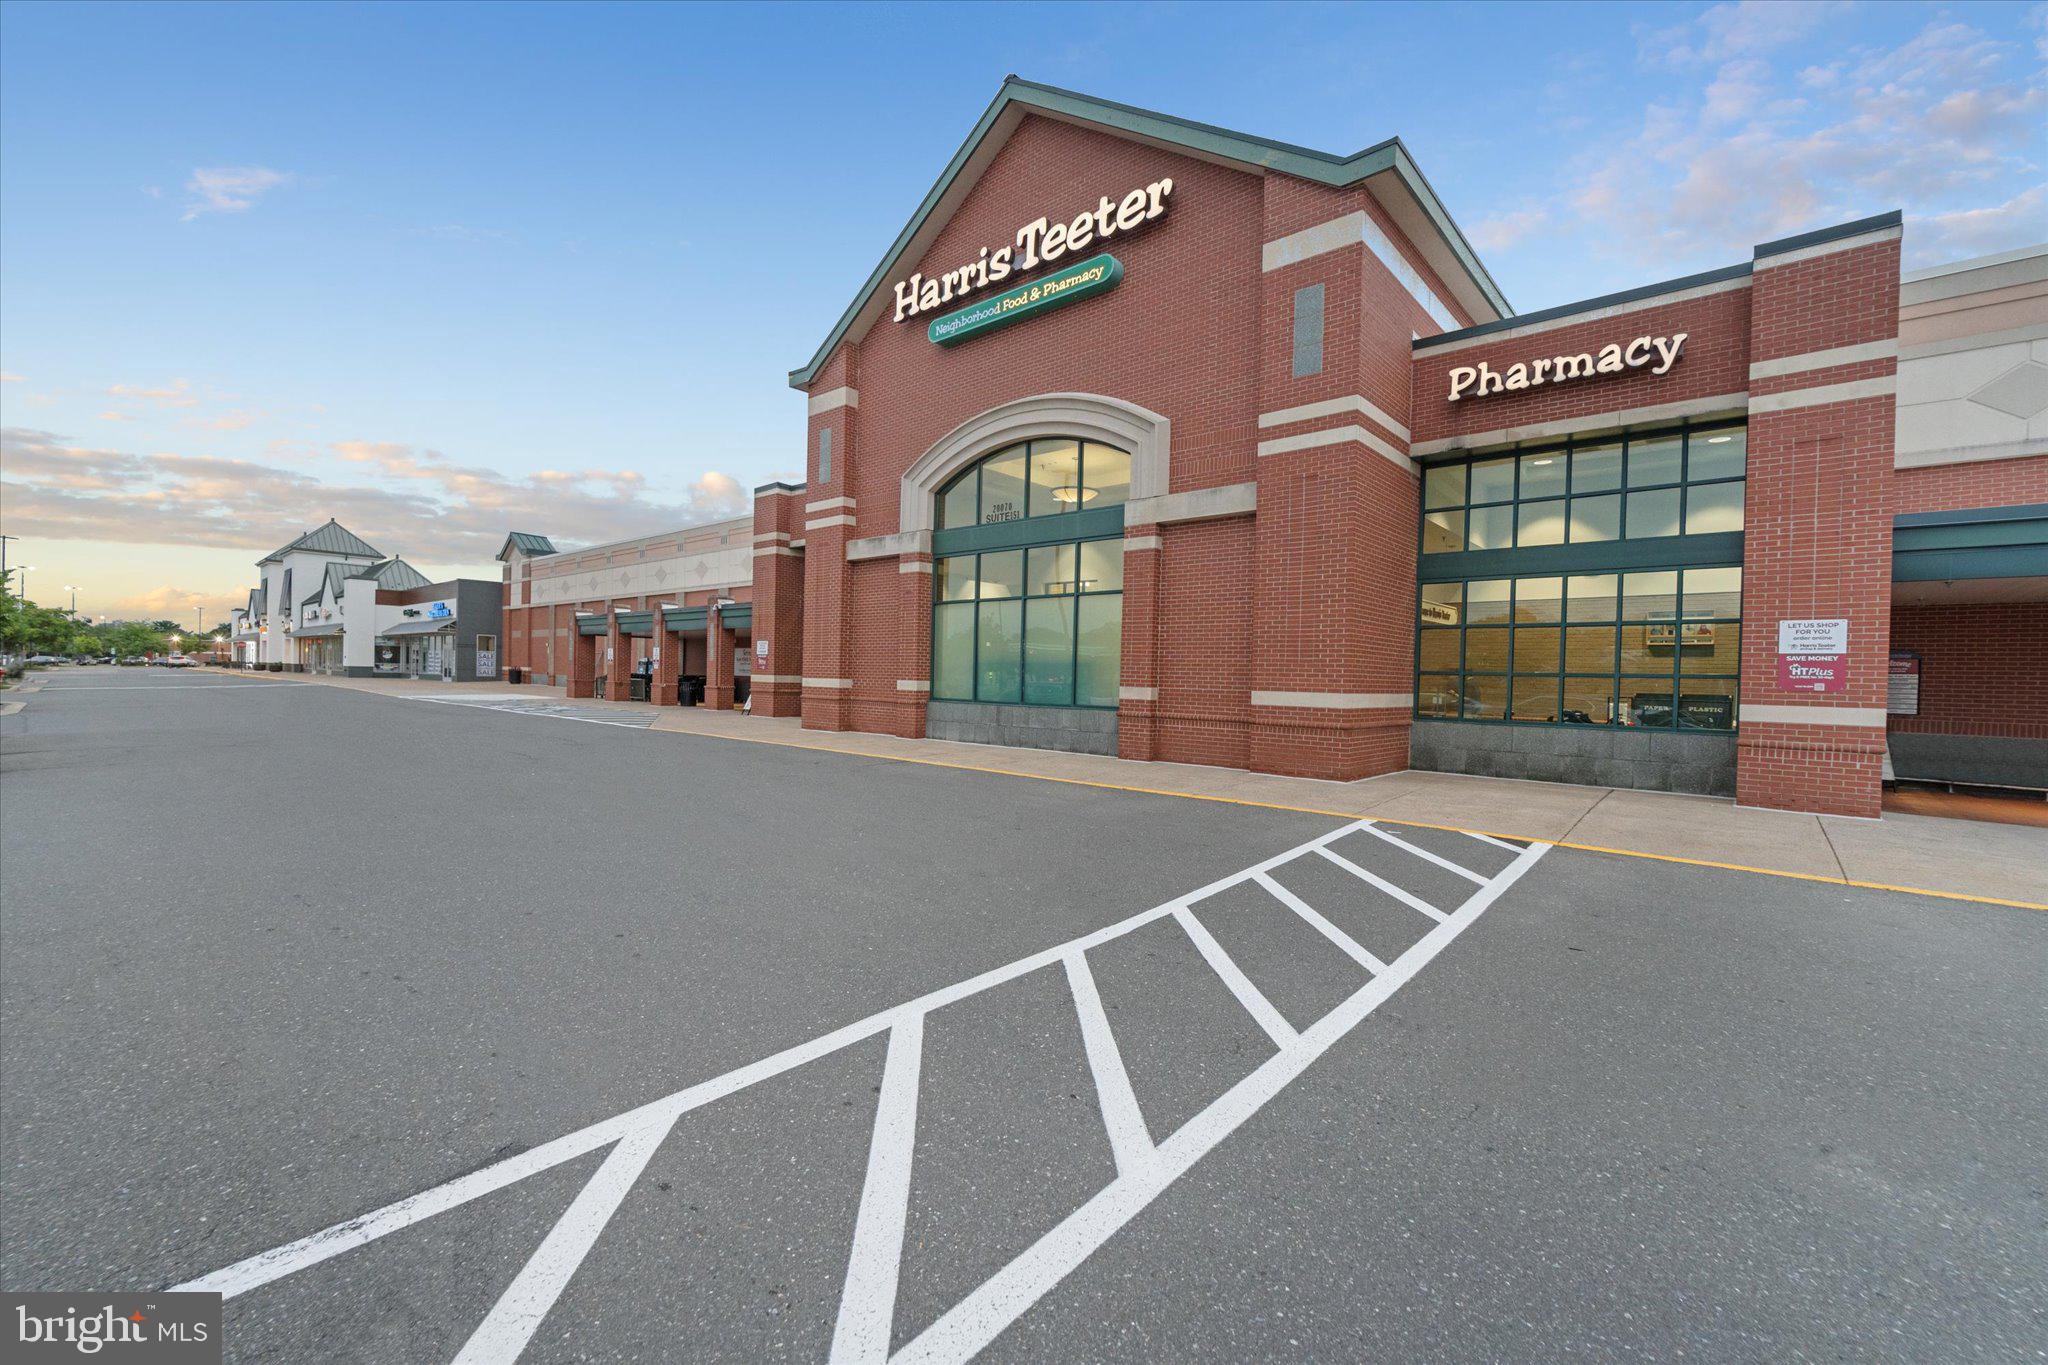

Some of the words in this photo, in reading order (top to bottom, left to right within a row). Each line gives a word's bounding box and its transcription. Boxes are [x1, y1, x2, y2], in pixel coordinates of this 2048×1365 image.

[893, 244, 1012, 323] Harris
[1016, 177, 1173, 270] Teeter
[934, 302, 1001, 336] Neighborhood
[1002, 291, 1029, 312] Food
[1029, 287, 1041, 301] &
[1043, 265, 1104, 297] Pharmacy
[1447, 333, 1688, 402] Pharmacy
